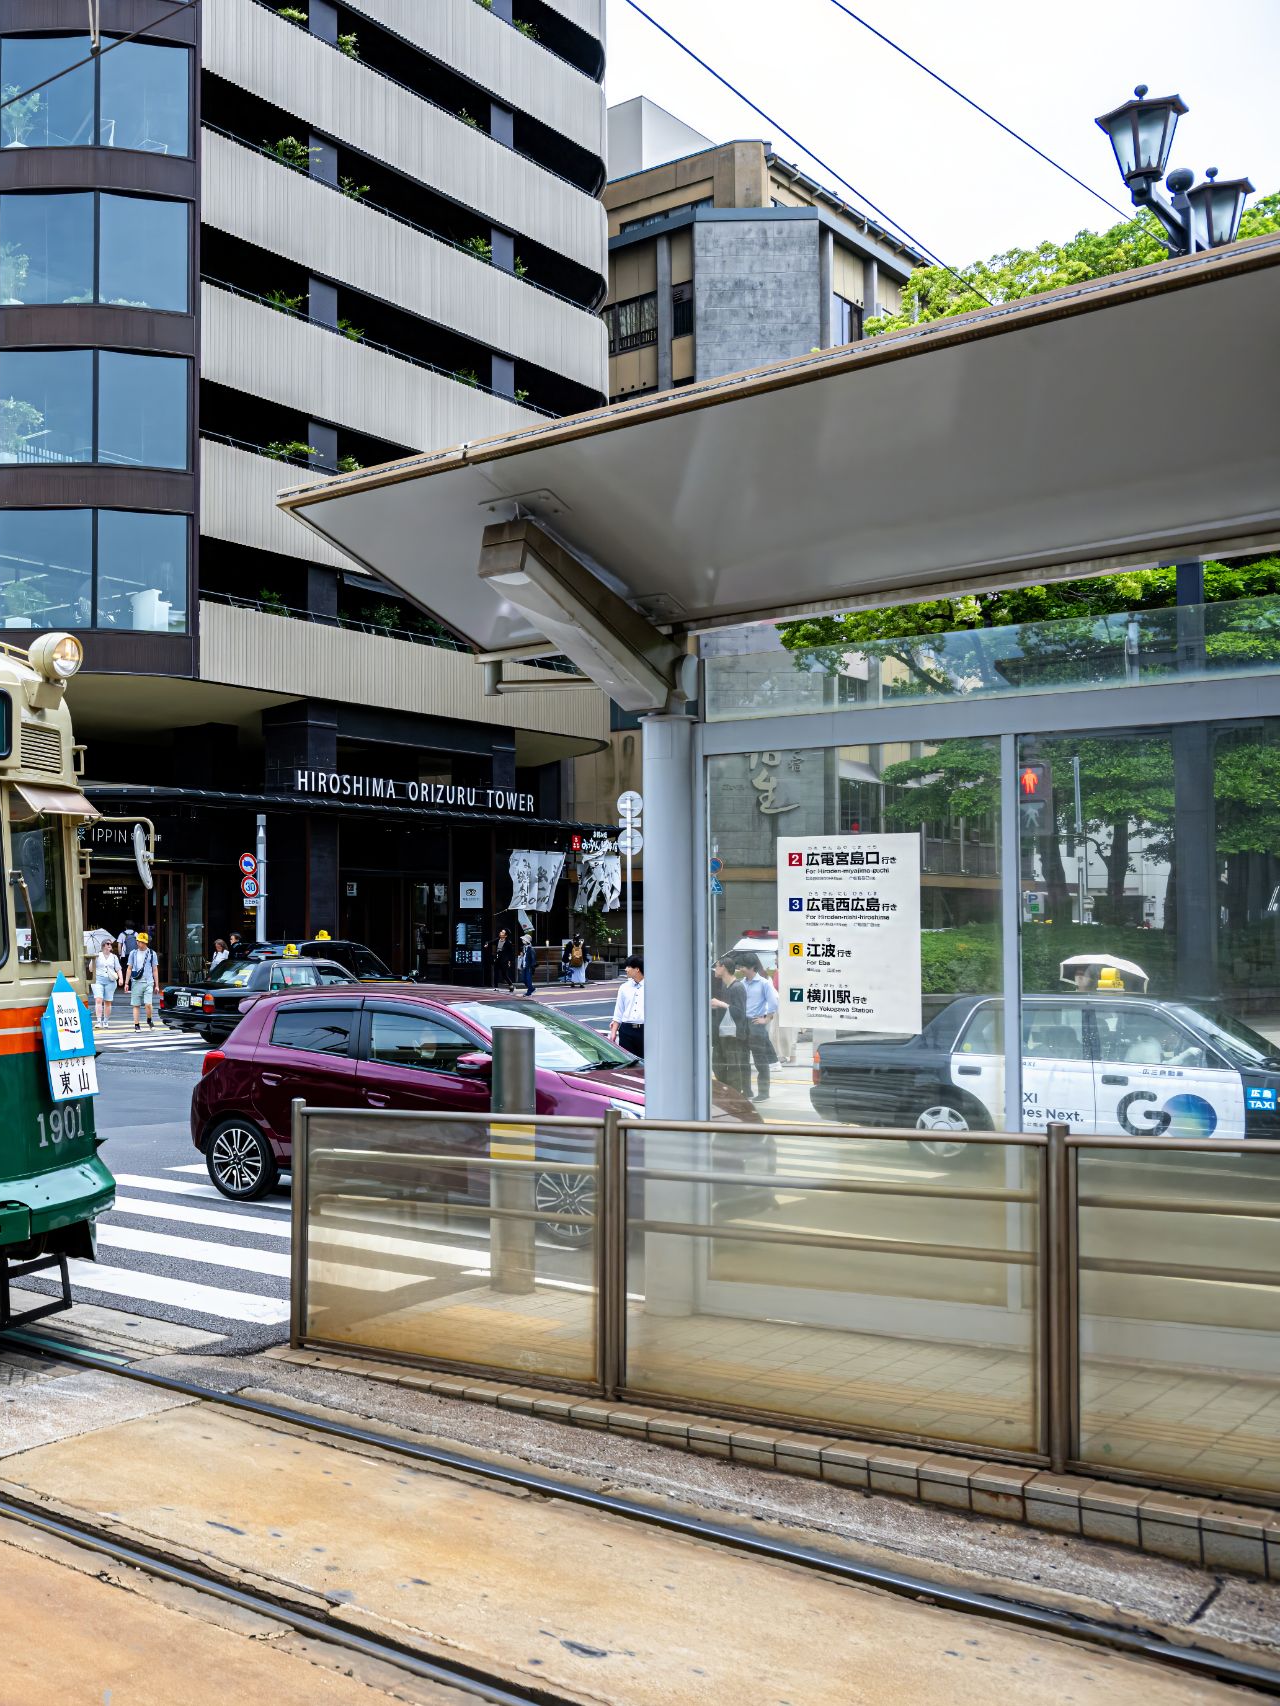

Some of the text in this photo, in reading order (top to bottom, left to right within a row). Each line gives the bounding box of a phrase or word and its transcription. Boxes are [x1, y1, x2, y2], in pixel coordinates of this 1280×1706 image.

[297, 769, 535, 812] HIROSHIMA ORIZURU TOWER
[91, 827, 127, 844] IPPIN
[791, 854, 800, 865] 2
[245, 881, 256, 892] 30
[791, 899, 800, 910] 3
[792, 944, 800, 955] 6
[792, 990, 801, 1001] 7
[58, 1016, 79, 1027] DAYS
[60, 1068, 90, 1095] 東山
[1250, 1089, 1272, 1099] 広島
[1249, 1100, 1275, 1110] TAXI
[1045, 1108, 1084, 1122] Next.
[37, 1103, 85, 1148] 1901
